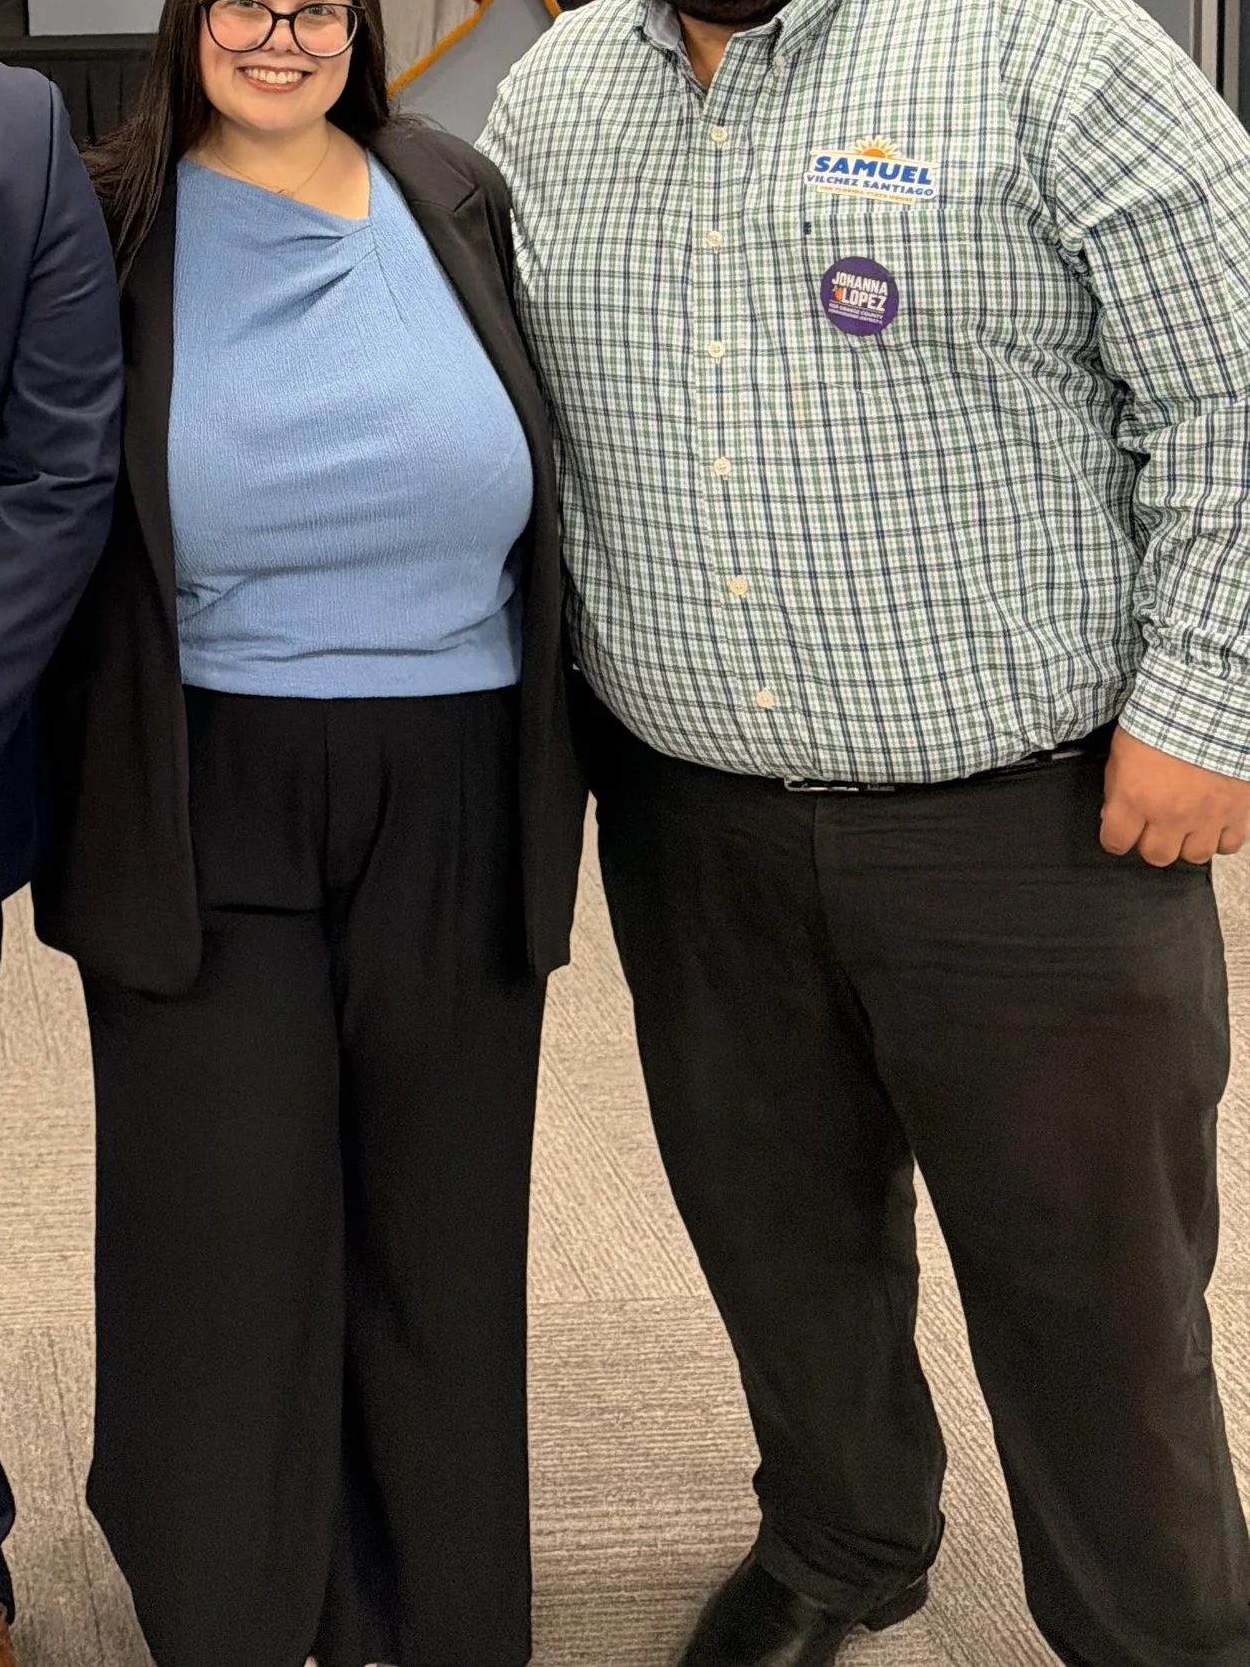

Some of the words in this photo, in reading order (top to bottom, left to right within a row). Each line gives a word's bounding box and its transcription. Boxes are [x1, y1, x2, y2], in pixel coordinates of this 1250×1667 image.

[814, 155, 932, 186] SAMUEL
[806, 174, 859, 187] VILCHEZ
[862, 180, 934, 197] SANTIAGO
[831, 271, 888, 296] JOHANNA
[841, 287, 888, 312] LOPEZ
